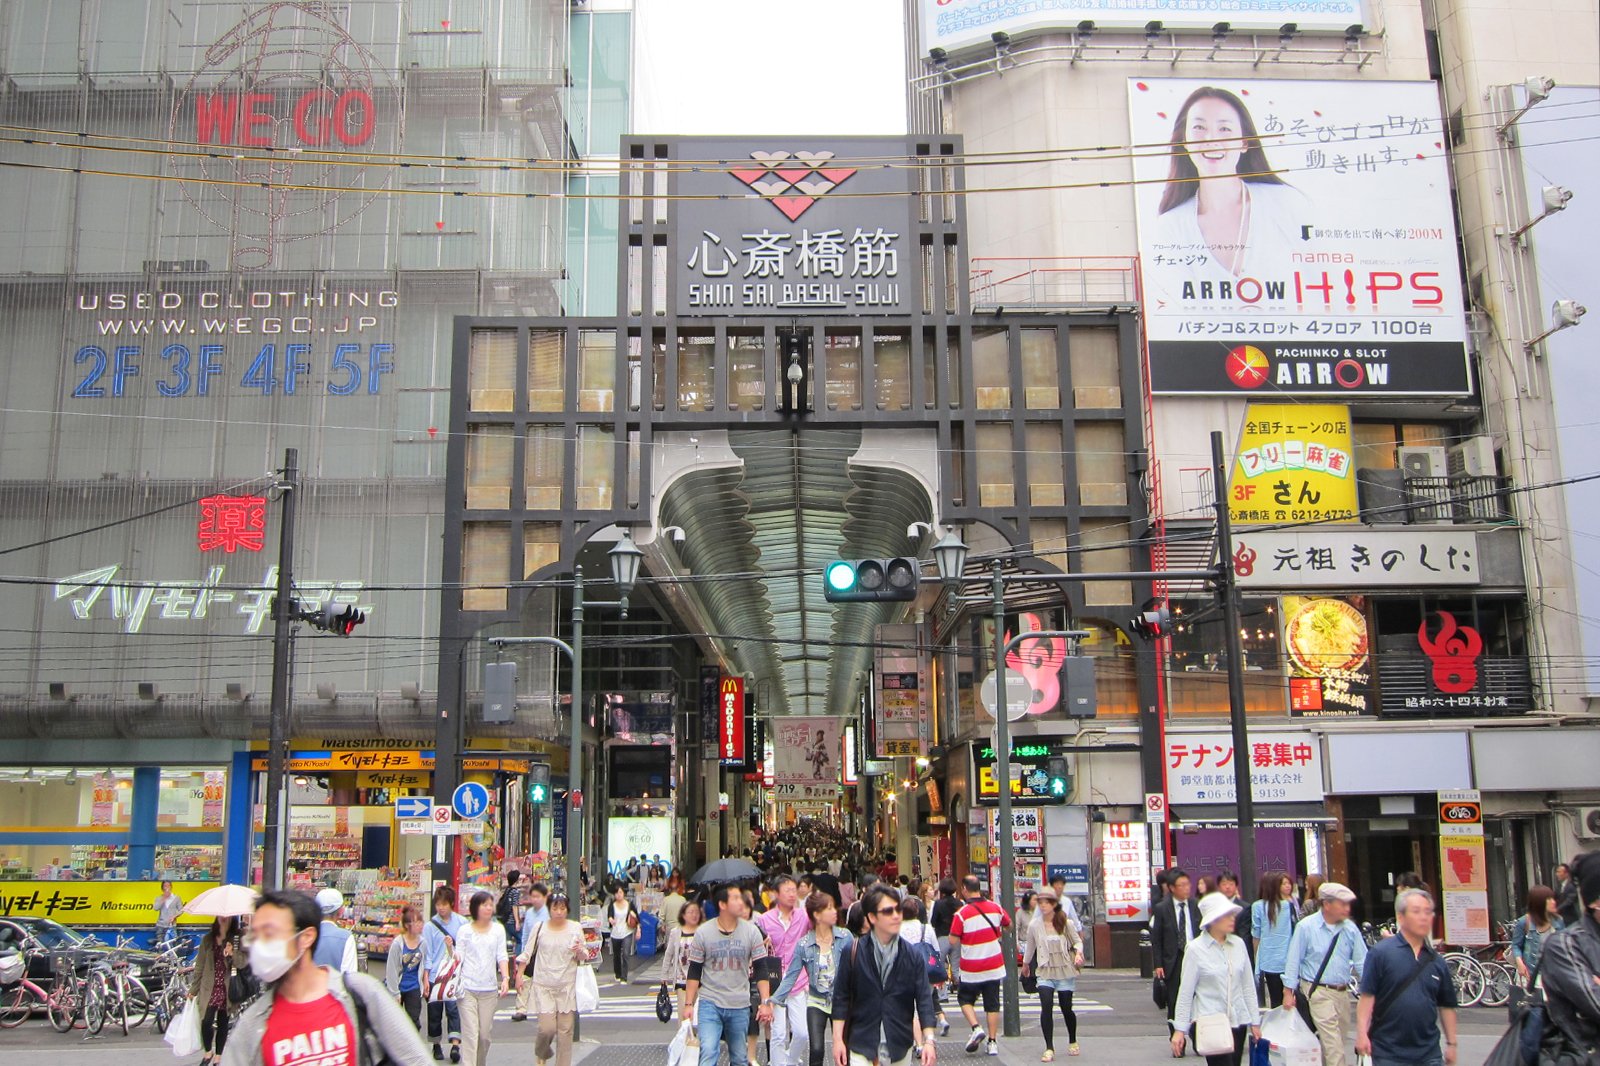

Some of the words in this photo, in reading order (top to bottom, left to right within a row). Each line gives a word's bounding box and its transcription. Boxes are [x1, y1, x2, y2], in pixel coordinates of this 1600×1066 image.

[196, 92, 275, 146] WE
[293, 90, 376, 147] GO
[1264, 114, 1430, 143] あそびゴコロが
[1306, 146, 1409, 174] 動き出す。
[687, 228, 899, 278] 心斎橋筋
[1153, 254, 1208, 266] チェ・ジウ
[79, 292, 184, 311] USED
[200, 290, 399, 309] CLOTHING
[689, 284, 734, 306] SHIN
[743, 284, 774, 306] SAI
[1182, 277, 1285, 304] ARROW
[98, 316, 378, 336] WWW.WEGO.JP
[1306, 321, 1362, 335] 4フロア
[1372, 321, 1432, 335] 1100台
[1275, 348, 1339, 358] PACHINKO
[1343, 348, 1351, 358] &
[1356, 348, 1387, 358] SLOT
[73, 345, 141, 398] 2F
[156, 344, 224, 397] 3F
[241, 344, 312, 396] 4F
[327, 343, 396, 396] 5F
[1276, 359, 1388, 388] ARROW
[1246, 421, 1347, 435] 全国チェーンの店
[1245, 445, 1345, 471] フリー麻雀
[1234, 485, 1256, 501] 3F
[1273, 480, 1321, 505] さん
[199, 494, 267, 553] 薬
[1273, 546, 1336, 572] 元祖
[1350, 543, 1472, 573] きのした
[1405, 696, 1508, 708] 昭和六十四年創業
[339, 752, 411, 768] マツモトキヨシ
[1169, 743, 1313, 769] テナン募集中
[1180, 773, 1303, 786] 御堂筋都市発株式会社
[273, 1023, 349, 1066] PAIN
